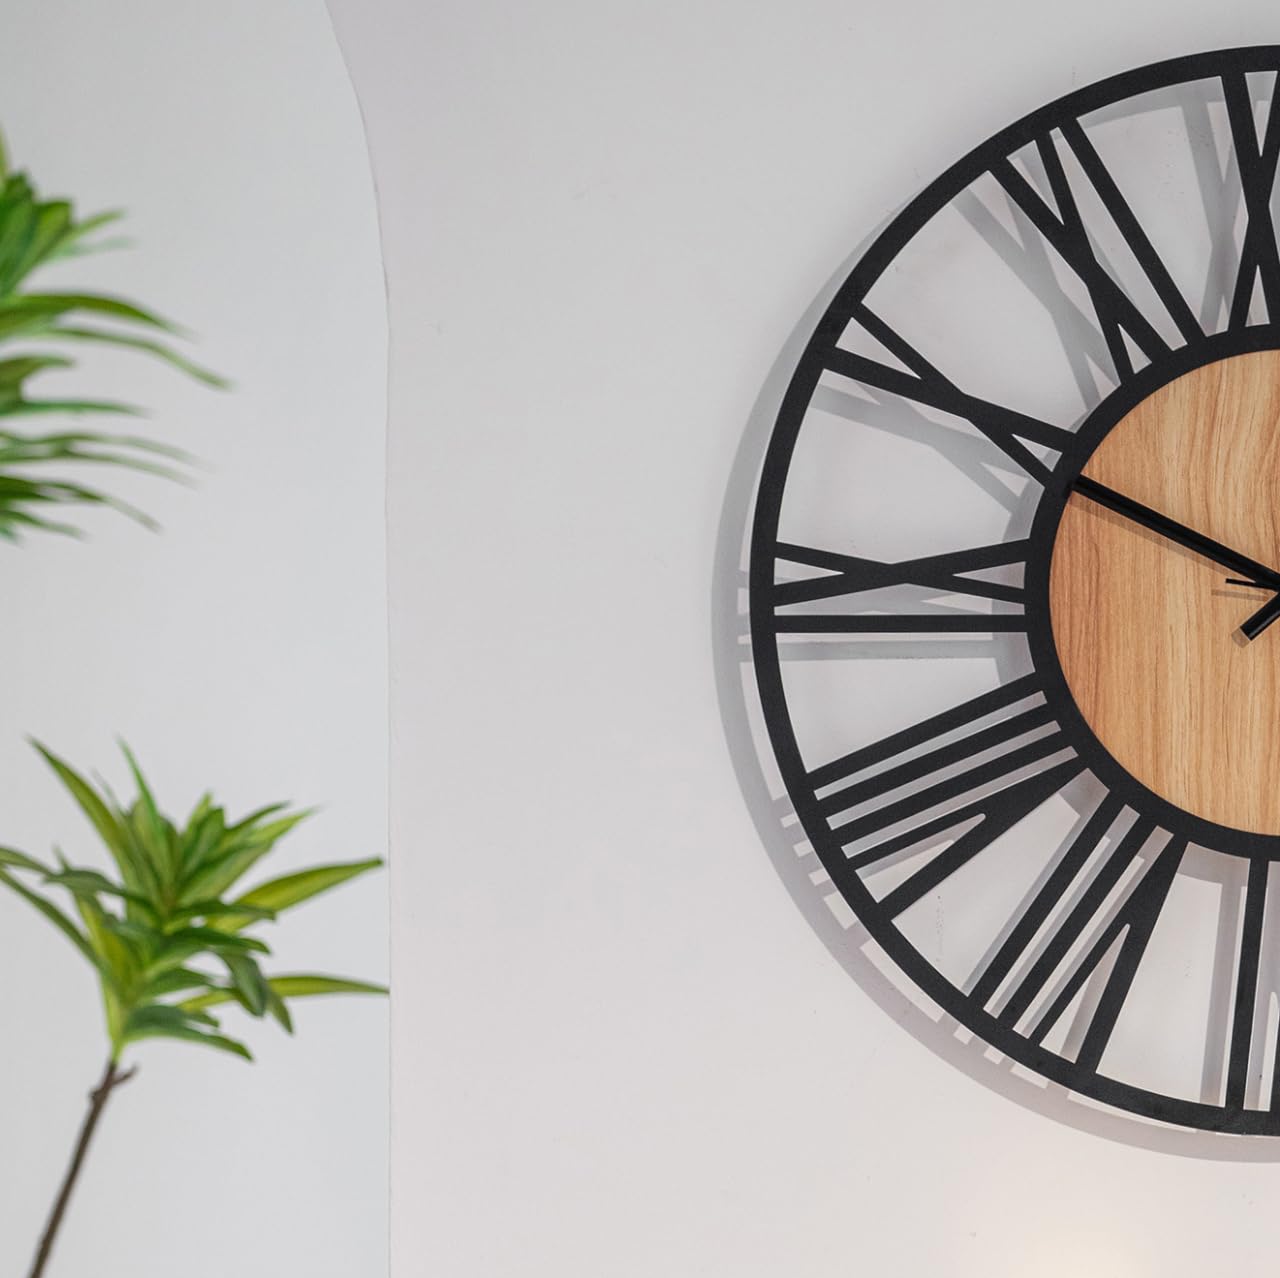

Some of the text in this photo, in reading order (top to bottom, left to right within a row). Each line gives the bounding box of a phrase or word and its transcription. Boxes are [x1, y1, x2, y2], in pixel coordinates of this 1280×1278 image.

[988, 118, 1206, 385] XI
[824, 302, 1076, 488] X
[773, 538, 1030, 633] IX
